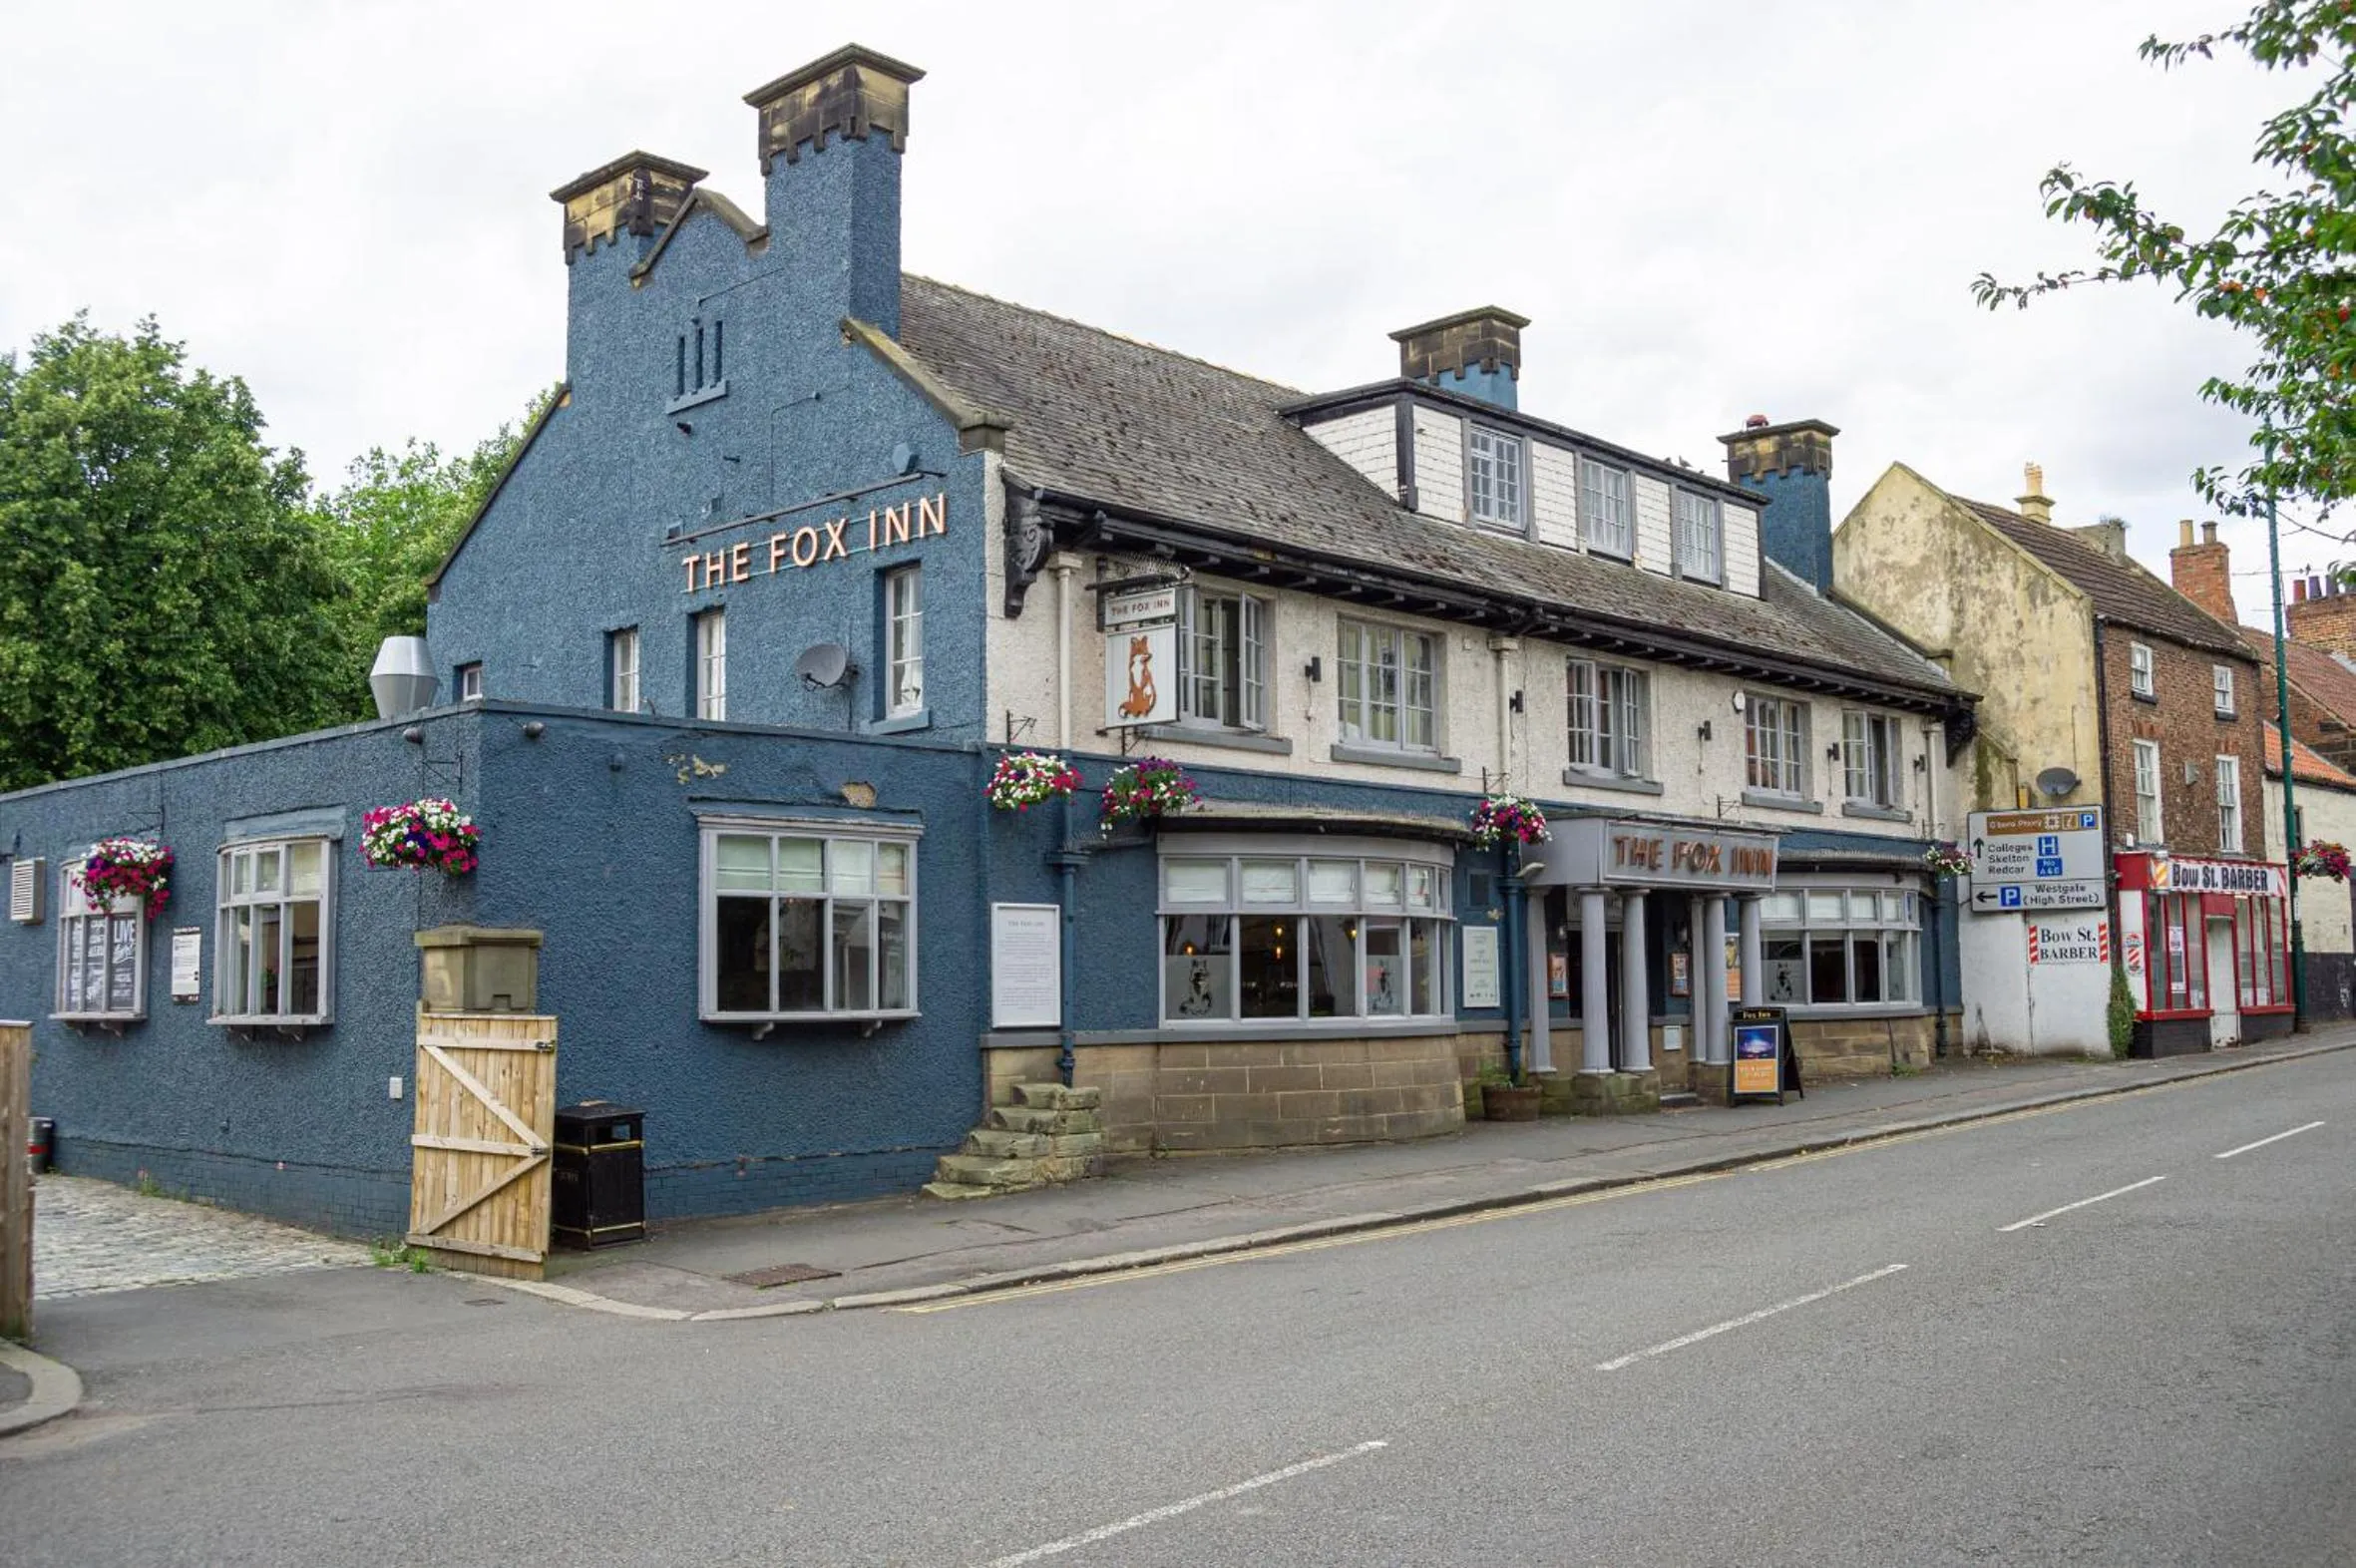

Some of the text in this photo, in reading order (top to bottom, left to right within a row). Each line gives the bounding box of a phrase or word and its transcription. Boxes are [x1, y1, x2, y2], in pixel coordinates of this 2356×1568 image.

[681, 492, 947, 593] THE FOX INN
[1132, 600, 1149, 613] FOX
[1153, 597, 1171, 609] INN
[1988, 843, 2033, 854] Colleges
[2041, 836, 2056, 856] H
[1613, 836, 1772, 878] THE FOX INN
[1988, 854, 2030, 864] Skelton
[1988, 865, 2026, 875] Redcar
[2220, 867, 2269, 892] BARBER
[2035, 884, 2086, 894] Westgate
[2023, 894, 2100, 906] (High Street)
[2077, 926, 2097, 942] St.
[2040, 946, 2098, 960] BARBER
